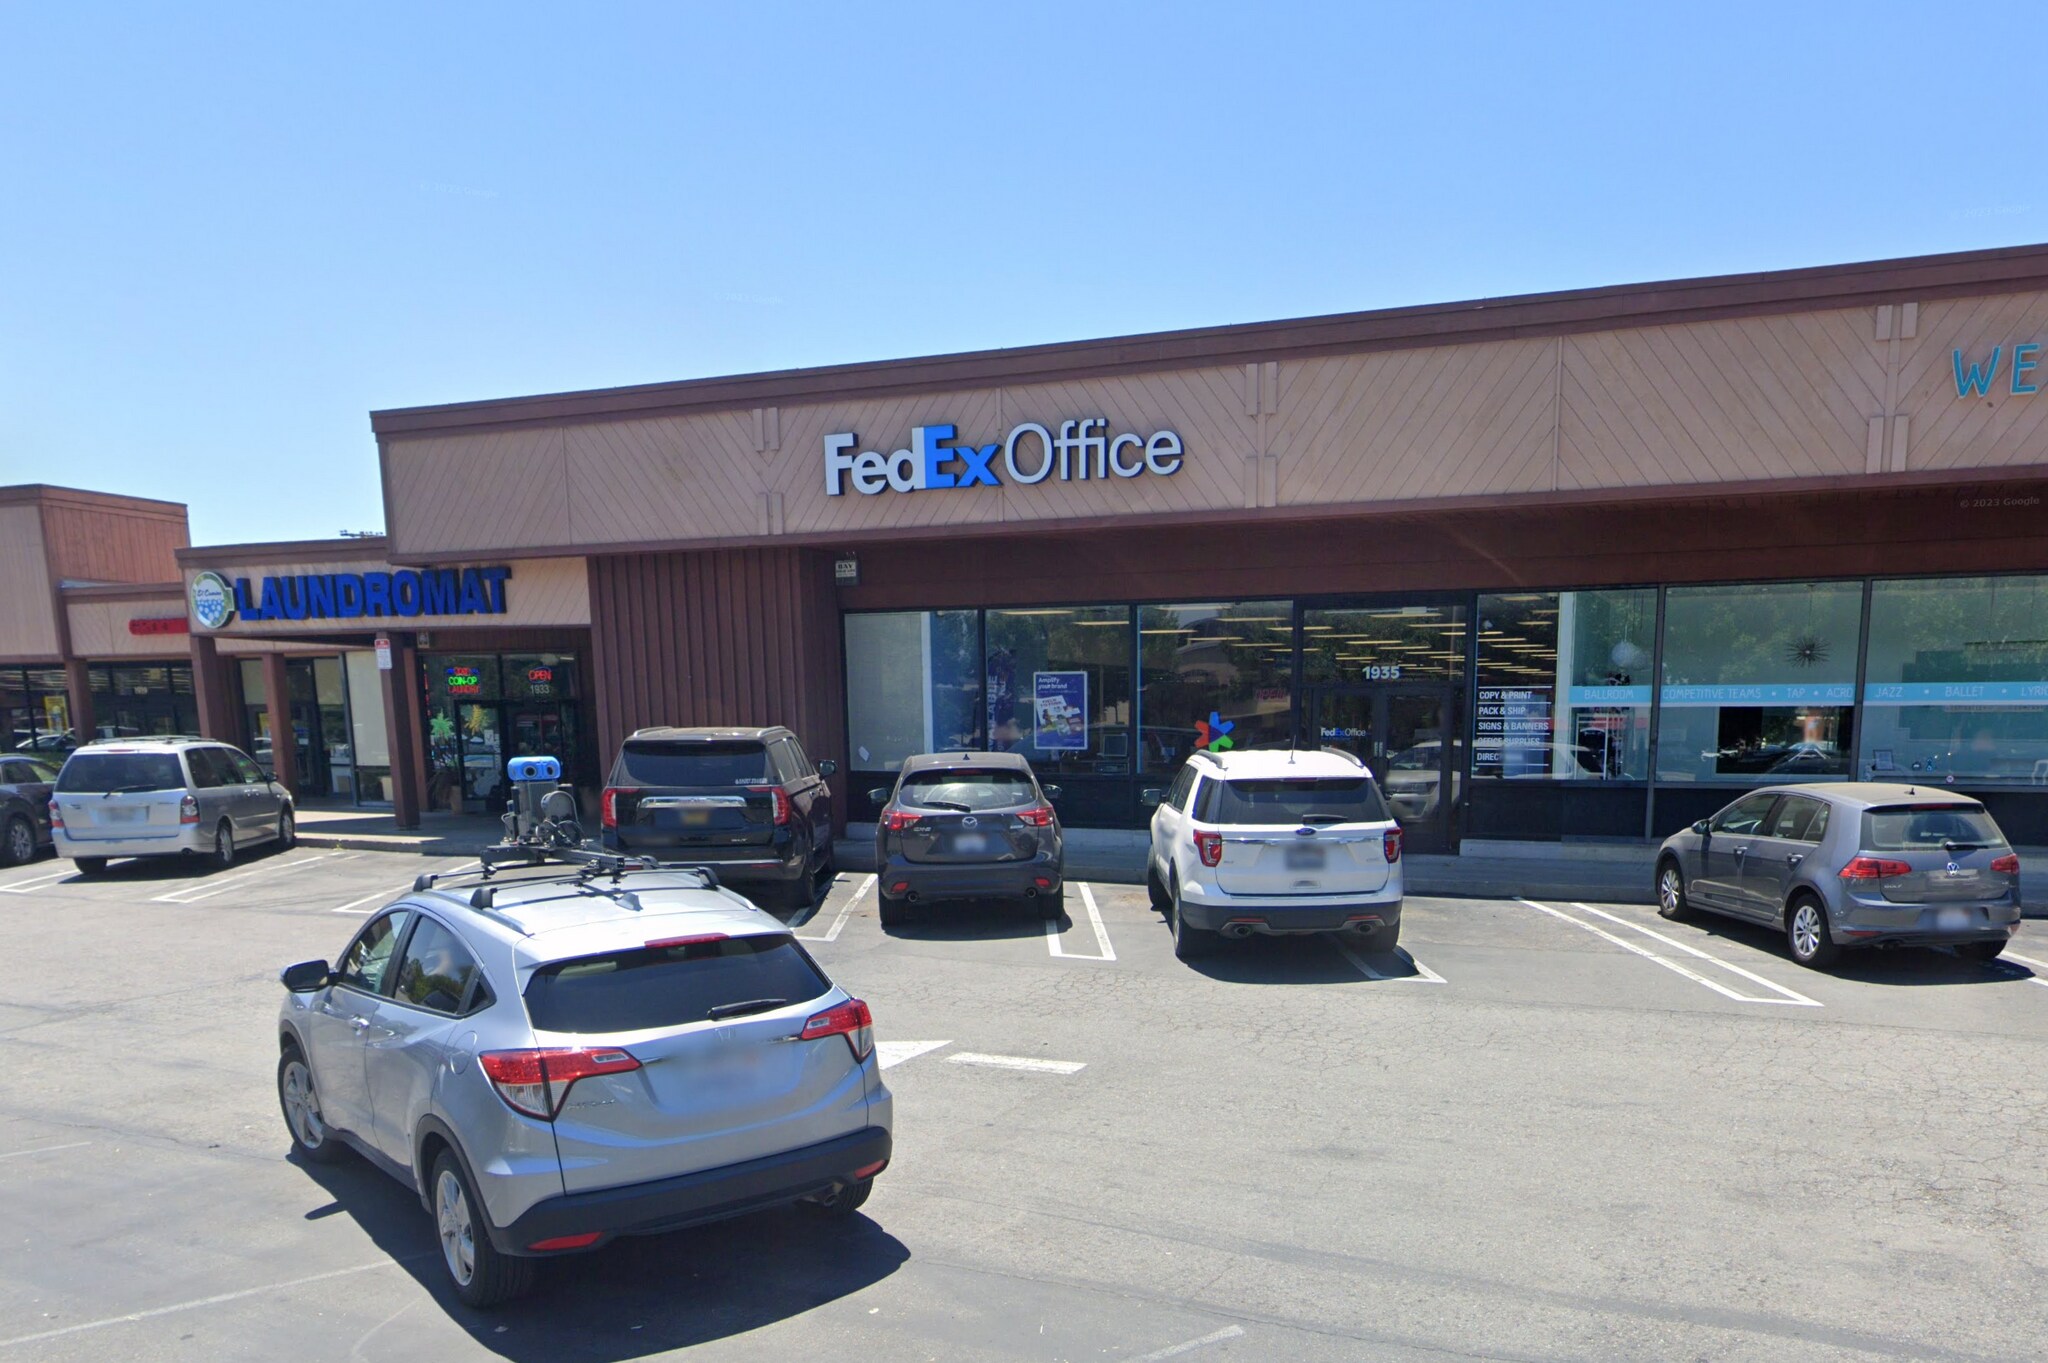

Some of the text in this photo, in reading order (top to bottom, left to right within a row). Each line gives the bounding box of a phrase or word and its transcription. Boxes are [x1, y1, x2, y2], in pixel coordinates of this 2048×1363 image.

[824, 418, 1184, 496] FedEx Office
[236, 567, 512, 621] LAUNDROMAT
[528, 670, 553, 681] OPEN
[1362, 666, 1400, 680] 1935
[1479, 691, 1532, 699] COPY & PRINT
[1584, 689, 1634, 700] BALLROOM
[1663, 688, 1761, 699] COMPETITIVE TEAMS
[1787, 687, 1805, 698] TAP
[1875, 687, 1903, 698] JAZZ
[1945, 686, 1984, 697] BALLET
[1479, 707, 1526, 715] PACK & SHIP
[1478, 722, 1549, 730] SIGNS & BANNERS
[1320, 727, 1367, 737] FedEx Office
[1504, 737, 1540, 746] SUPPLIES
